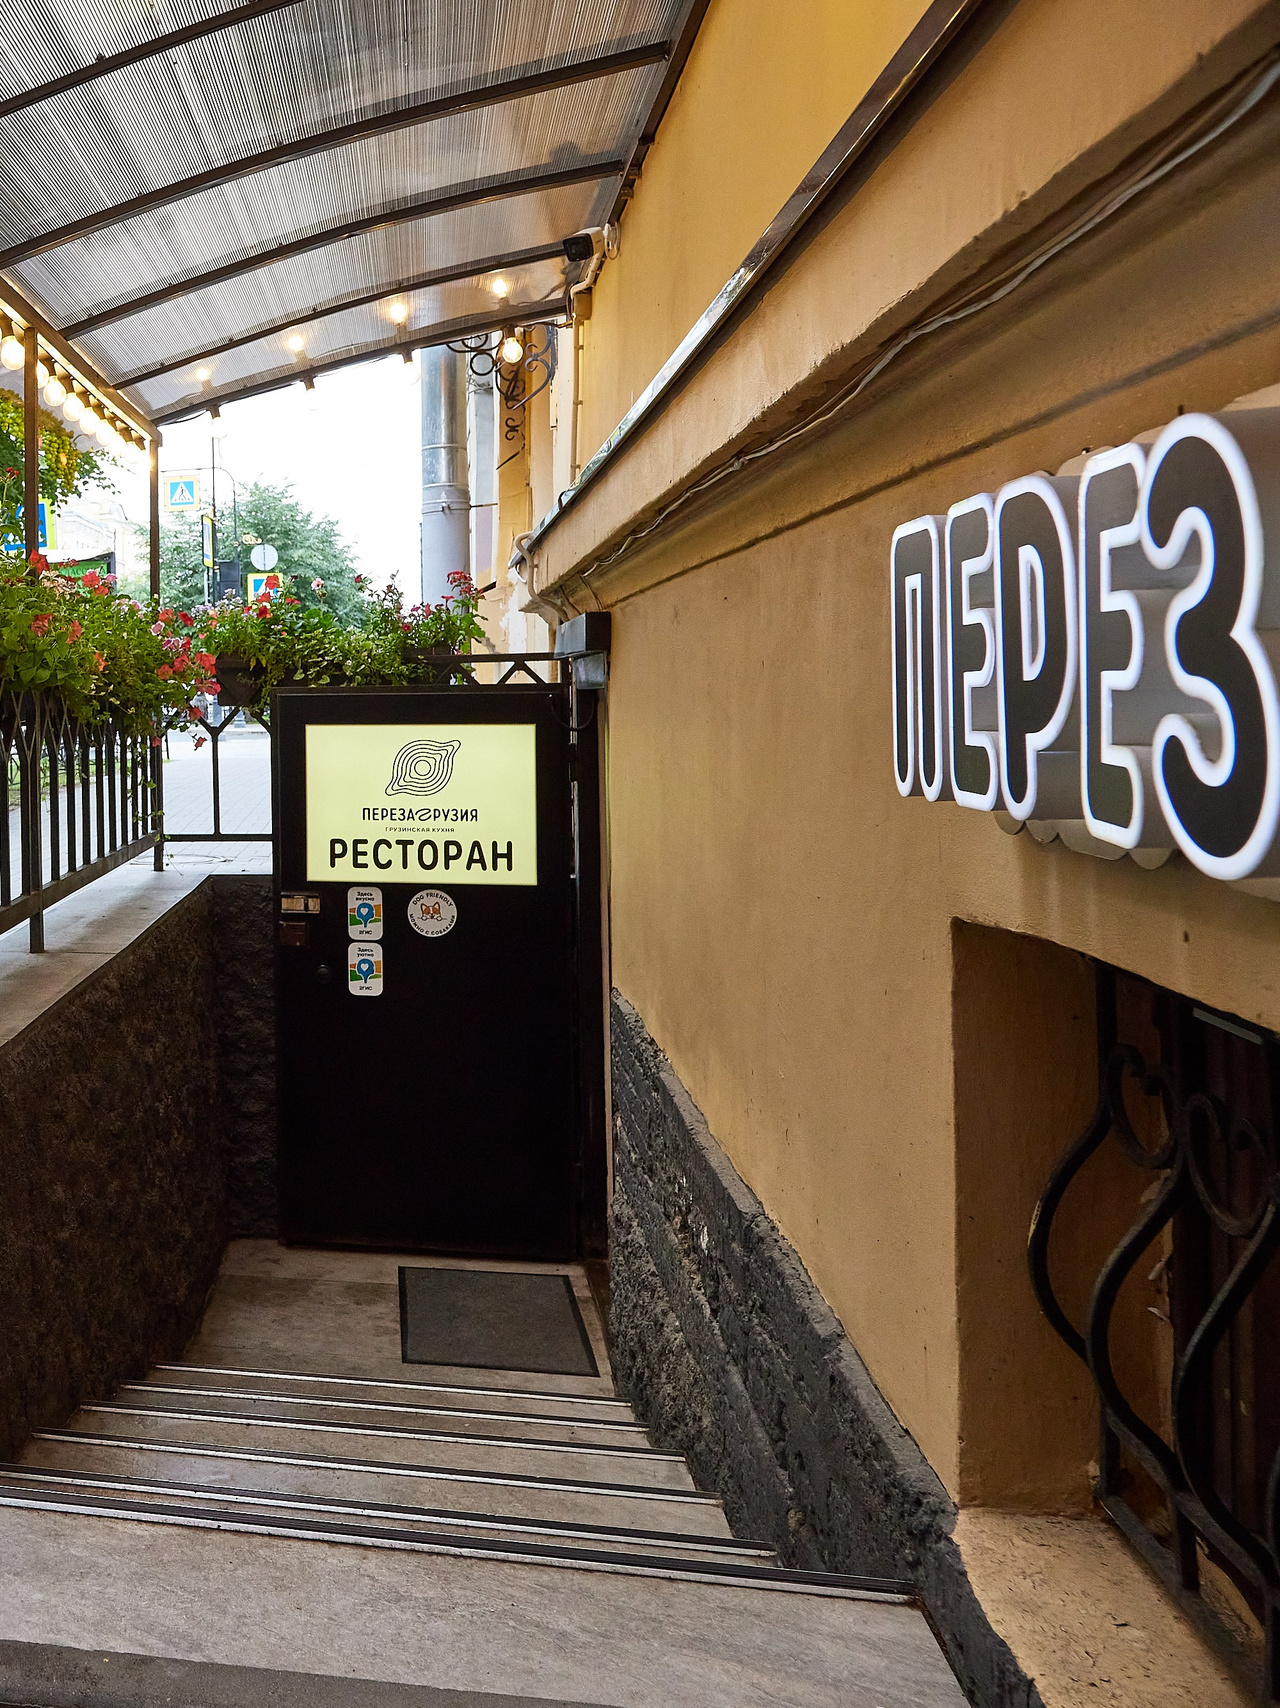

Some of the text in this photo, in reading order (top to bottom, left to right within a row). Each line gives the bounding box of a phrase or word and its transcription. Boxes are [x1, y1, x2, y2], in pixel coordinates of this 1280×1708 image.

[891, 412, 1280, 881] ПЕРЕЗ
[362, 807, 478, 822] ПЕРЕЗАГРУЗИЯ
[330, 838, 513, 871] РЕСТОРАН
[412, 892, 454, 907] DOG FRIENDLY
[409, 913, 424, 933] МОЖНО
[431, 915, 456, 935] СОБАКАМИ
